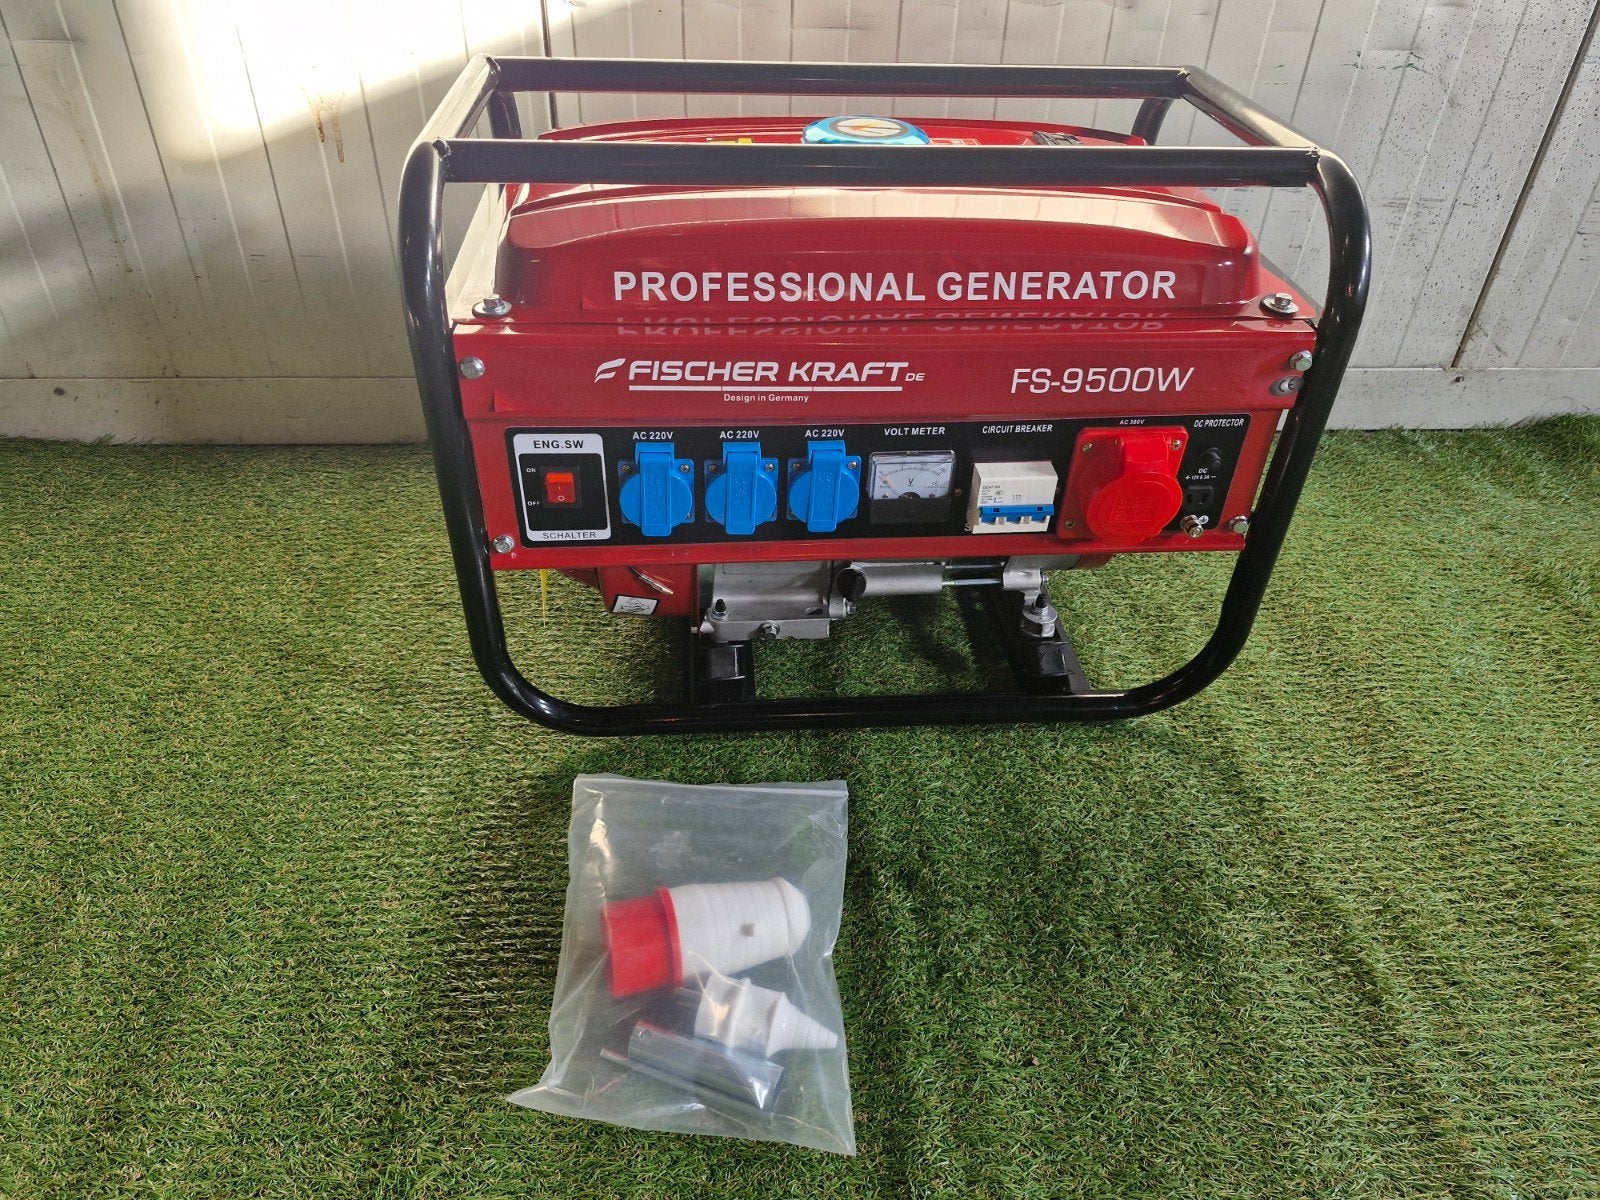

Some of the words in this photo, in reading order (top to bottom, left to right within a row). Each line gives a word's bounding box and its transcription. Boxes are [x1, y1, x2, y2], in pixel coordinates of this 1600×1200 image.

[614, 271, 926, 302] PROFESSIONAL
[936, 270, 1177, 301] GENERATOR
[628, 360, 779, 383] FISCHER
[788, 360, 909, 383] KRAFT
[905, 373, 925, 382] DE
[1010, 366, 1194, 395] FS-9500W
[724, 393, 756, 403] Design
[757, 393, 766, 402] in
[768, 393, 809, 403] Germany
[1193, 419, 1203, 428] DC
[1203, 418, 1245, 427] PROTECTOR
[804, 429, 820, 438] AC
[821, 429, 845, 438] 220V
[884, 427, 909, 436] VOLT
[911, 426, 946, 435] METER
[982, 425, 1014, 434] CIRCUIT
[1014, 424, 1053, 433] BREAKER
[632, 431, 647, 440] AC
[649, 431, 673, 440] 220V
[719, 430, 735, 439] AC
[736, 430, 760, 439] 220V
[533, 439, 584, 449] ENG.SW
[542, 532, 597, 540] SCHALTER
